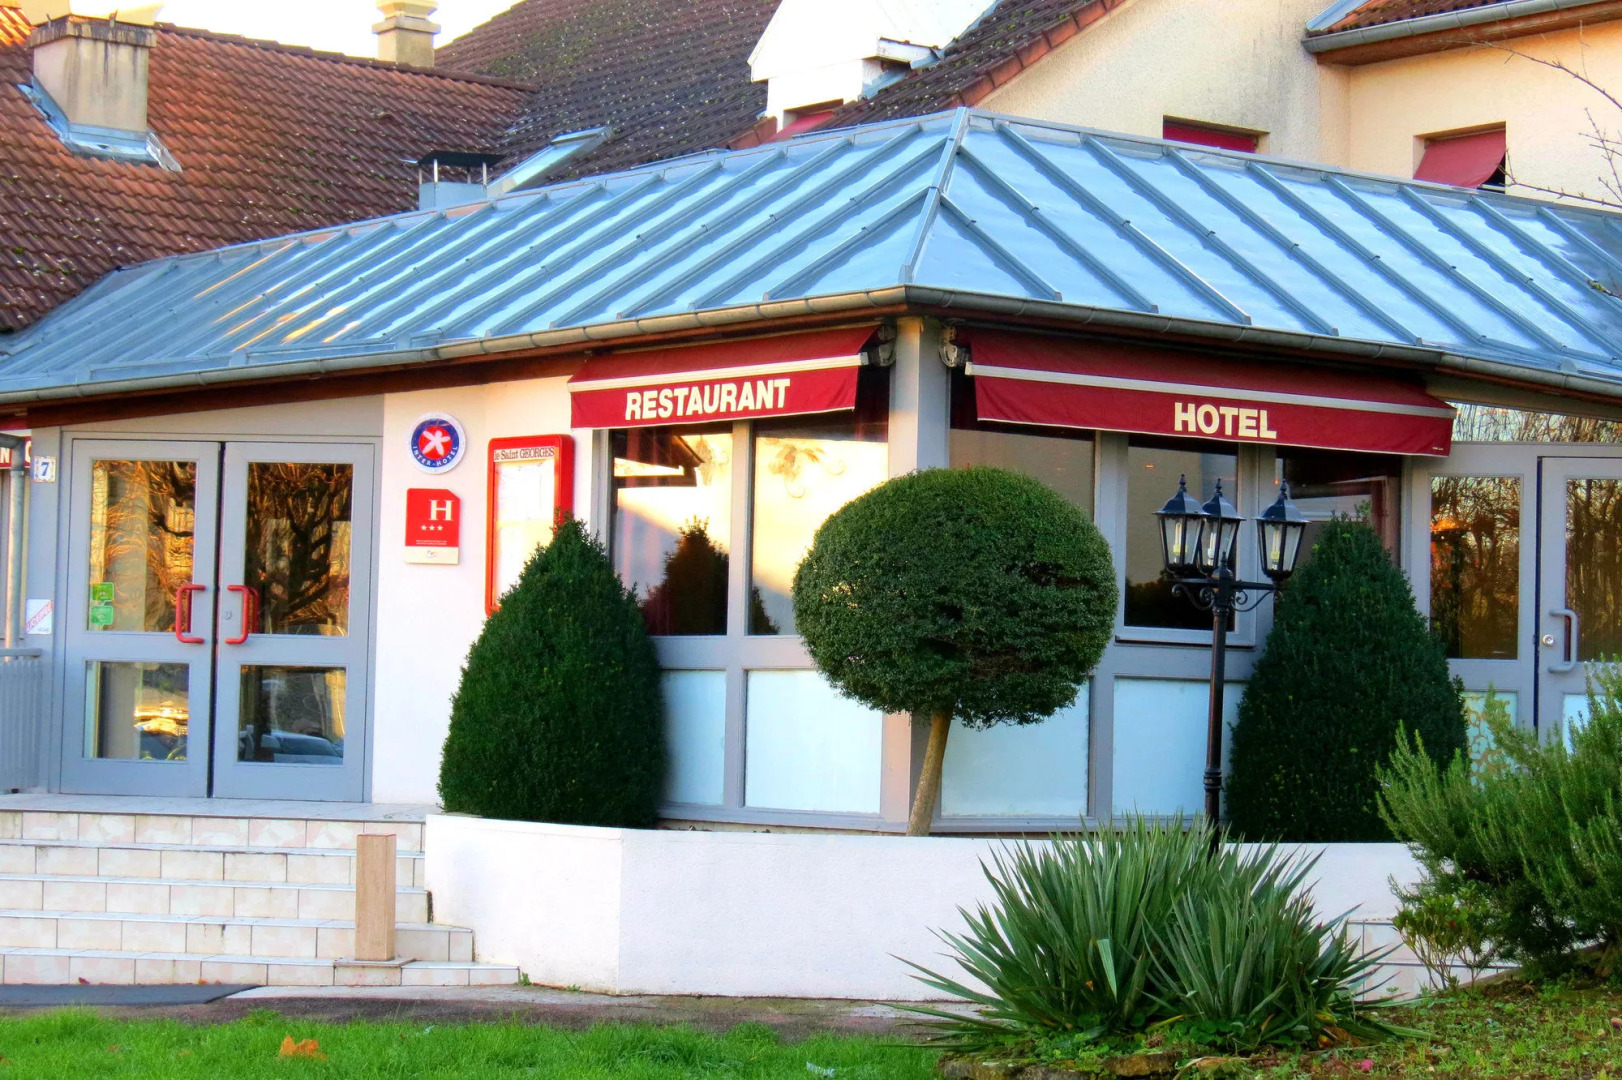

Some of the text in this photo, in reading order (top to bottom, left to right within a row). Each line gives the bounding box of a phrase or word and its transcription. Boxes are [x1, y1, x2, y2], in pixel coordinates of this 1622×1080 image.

[625, 378, 791, 421] RESTAURANT
[1174, 402, 1277, 439] HOTEL
[501, 449, 519, 460] Saint
[520, 446, 555, 460] GEORGES
[41, 461, 50, 477] 7
[428, 499, 455, 521] H
